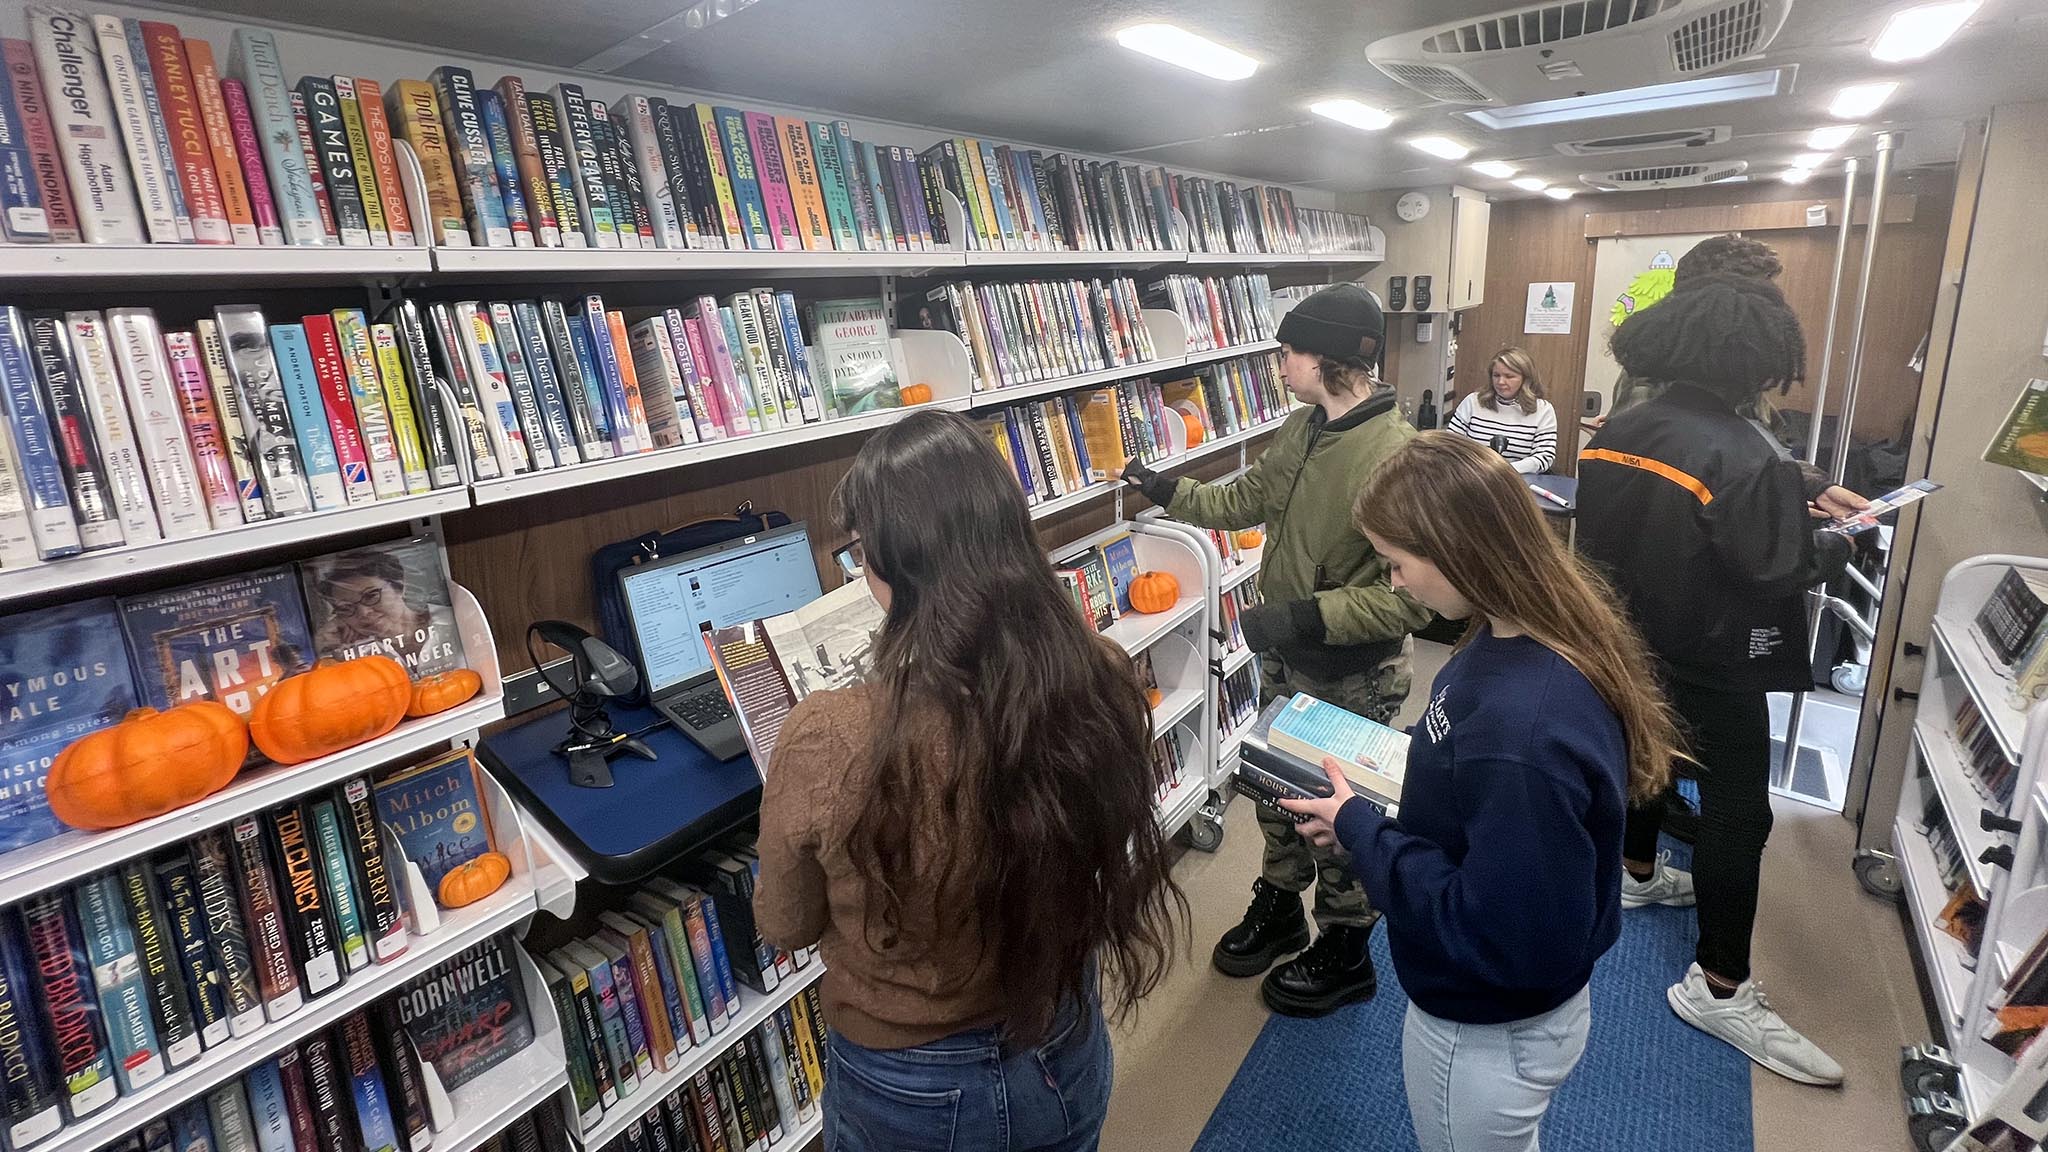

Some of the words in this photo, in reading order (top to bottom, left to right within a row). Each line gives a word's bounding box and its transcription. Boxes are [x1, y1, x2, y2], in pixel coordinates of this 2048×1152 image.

[50, 16, 92, 119] Challenger
[250, 36, 278, 69] Judi
[158, 35, 188, 103] STANLEY
[177, 108, 204, 156] TUCCI
[259, 73, 288, 122] Dench
[312, 82, 329, 90] THE
[113, 54, 134, 104] CONTAINER
[142, 163, 163, 211] HANDBOOK
[227, 82, 259, 165] HEARTBREAK
[297, 120, 307, 131] ON
[368, 107, 383, 126] THE
[452, 74, 470, 109] CLIVE
[461, 112, 487, 165] CUSSLER
[513, 80, 527, 113] JANET
[520, 114, 538, 150] DAILEY
[531, 99, 546, 131] DEAVER
[543, 100, 558, 132] JEFFERY
[19, 79, 37, 114] MIND
[28, 118, 46, 149] OVER
[38, 153, 68, 224] MENOPAUSE
[301, 134, 313, 148] THE
[314, 92, 352, 178] GAMES
[350, 127, 368, 162] ESSENCE
[374, 129, 391, 165] BOYS
[566, 89, 591, 151] JEFFERY
[581, 151, 605, 201] DEAVER
[657, 105, 673, 142] ORDER
[670, 155, 687, 193] SWANS
[185, 162, 196, 173] IN
[305, 150, 318, 175] BALL
[539, 135, 559, 179] INTRUSION
[553, 146, 566, 169] FATAL
[602, 153, 613, 174] ARTIST
[732, 148, 747, 179] GODS
[763, 127, 784, 184] BUTCHER'S
[984, 157, 997, 186] END
[79, 143, 104, 212] Higginbotham
[100, 163, 115, 192] Adam
[189, 174, 201, 195] ONE
[201, 168, 215, 194] WHAT
[209, 198, 221, 218] ATE
[362, 172, 376, 196] MUAY
[368, 200, 380, 218] THAI
[389, 197, 407, 228] BOAT
[551, 183, 570, 232] MALDONADO
[563, 189, 579, 226] ISABELLA
[472, 318, 482, 343] Louise
[738, 298, 759, 343] HEARTWOOD
[761, 303, 777, 350] ALBRAITH
[822, 309, 882, 324] ELIZABETH
[835, 325, 878, 339] GEORGE
[0, 334, 19, 365] Travels
[33, 318, 53, 352] Killing
[530, 336, 543, 354] the
[790, 328, 803, 361] GARWOOD
[43, 355, 61, 370] the
[318, 357, 330, 379] DAYS
[322, 332, 335, 357] THESE
[330, 360, 346, 402] PRECIOUS
[353, 329, 366, 356] WILL
[360, 359, 378, 395] SMITH
[675, 335, 692, 375] FOSTER
[839, 354, 845, 364] A
[9, 369, 26, 388] with
[49, 371, 71, 410] Witches
[139, 369, 154, 398] One
[254, 360, 272, 390] JON
[288, 347, 302, 380] ANDREW
[298, 383, 312, 417] MORTON
[385, 348, 402, 400] well-adjusted
[420, 356, 436, 391] HENRY
[536, 358, 554, 391] heart
[16, 392, 29, 413] Mrs.
[179, 371, 208, 415] CLEAN
[513, 370, 524, 387] THE
[519, 389, 535, 420] POPPY
[546, 393, 559, 406] of
[22, 416, 45, 456] Kennedy
[192, 423, 217, 456] MESS
[334, 419, 350, 460] PATCHETT
[347, 429, 357, 447] ANN
[1622, 456, 1641, 467] NASA
[1086, 570, 1103, 589] RKE
[199, 623, 243, 647] THE
[343, 634, 405, 661] HEART
[414, 625, 436, 643] OF
[180, 640, 272, 699] ART
[394, 642, 453, 668] NGER
[6, 662, 107, 697] YMOUS
[0, 696, 61, 725] ALE
[3, 730, 61, 751] Among
[66, 715, 111, 734] Spies
[388, 777, 462, 813] Mitch
[1258, 775, 1289, 795] HOUSE
[276, 809, 303, 847] TOM
[392, 798, 472, 837] Albom
[322, 826, 335, 856] PEACOCK
[335, 883, 350, 915] SPARROW
[352, 801, 376, 853] STEVE
[365, 855, 390, 907] BERRY
[171, 876, 184, 890] No
[248, 869, 266, 912] FLYNN
[287, 848, 321, 913] CLANCY
[88, 883, 103, 915] MARY
[200, 873, 233, 934] WILDES
[128, 874, 146, 910] JOHN
[139, 911, 165, 976] BANVILLE
[311, 918, 326, 946] ZERO
[377, 913, 389, 932] LIST
[386, 911, 396, 924] THE
[31, 914, 73, 977] DAVID
[94, 915, 115, 960] BALOGH
[263, 912, 280, 947] DENIED
[272, 949, 290, 991] ACCESS
[156, 980, 166, 995] The
[221, 939, 234, 972] LOUIS
[229, 974, 247, 1012] BAYARD
[398, 949, 511, 1025] CORNWELL
[808, 987, 819, 1012] DEAN
[44, 974, 96, 1073] BALDACCI
[122, 987, 148, 1049] REMEMBER
[160, 995, 183, 1043] Lock-Up
[351, 1015, 375, 1069] STRANGER
[305, 1041, 333, 1111] Gothictown
[363, 1080, 375, 1106] JANE
[371, 1106, 385, 1140] CASEY
